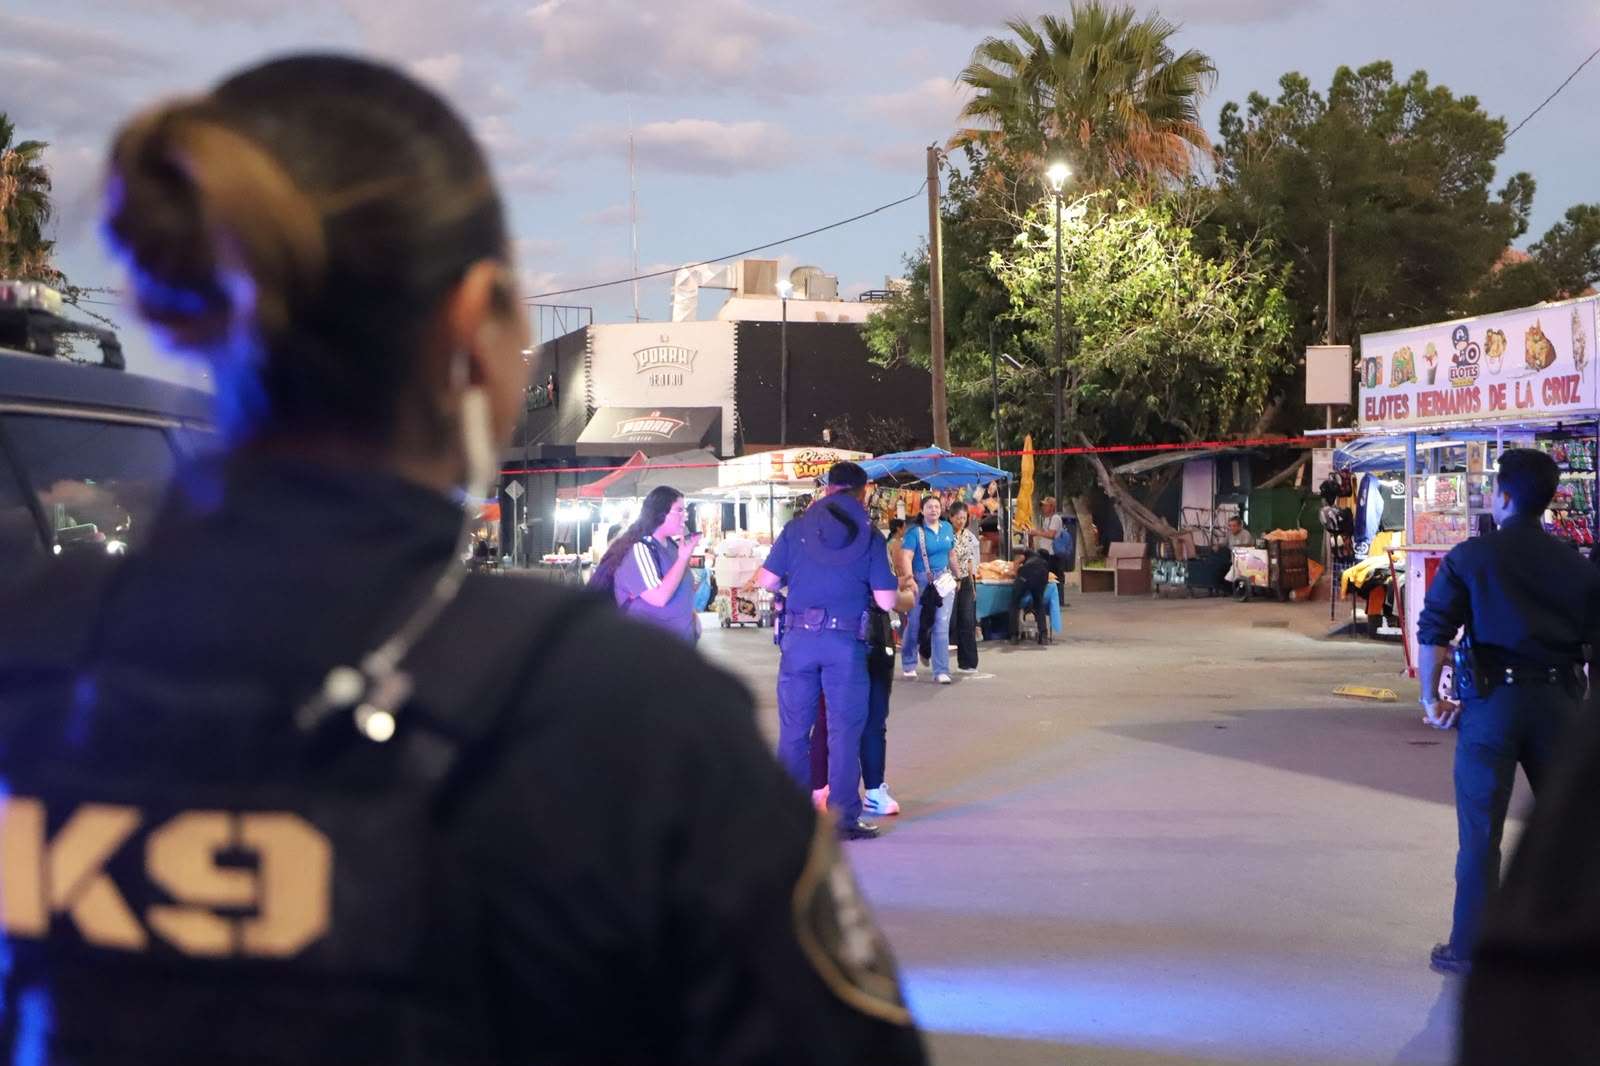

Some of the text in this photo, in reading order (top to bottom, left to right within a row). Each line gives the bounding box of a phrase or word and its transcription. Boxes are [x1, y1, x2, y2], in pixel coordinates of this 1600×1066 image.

[1450, 366, 1478, 379] ELOTES
[1365, 374, 1581, 422] ELOTES HERMANOS DE LA CRUZ
[0, 795, 334, 958] K9
